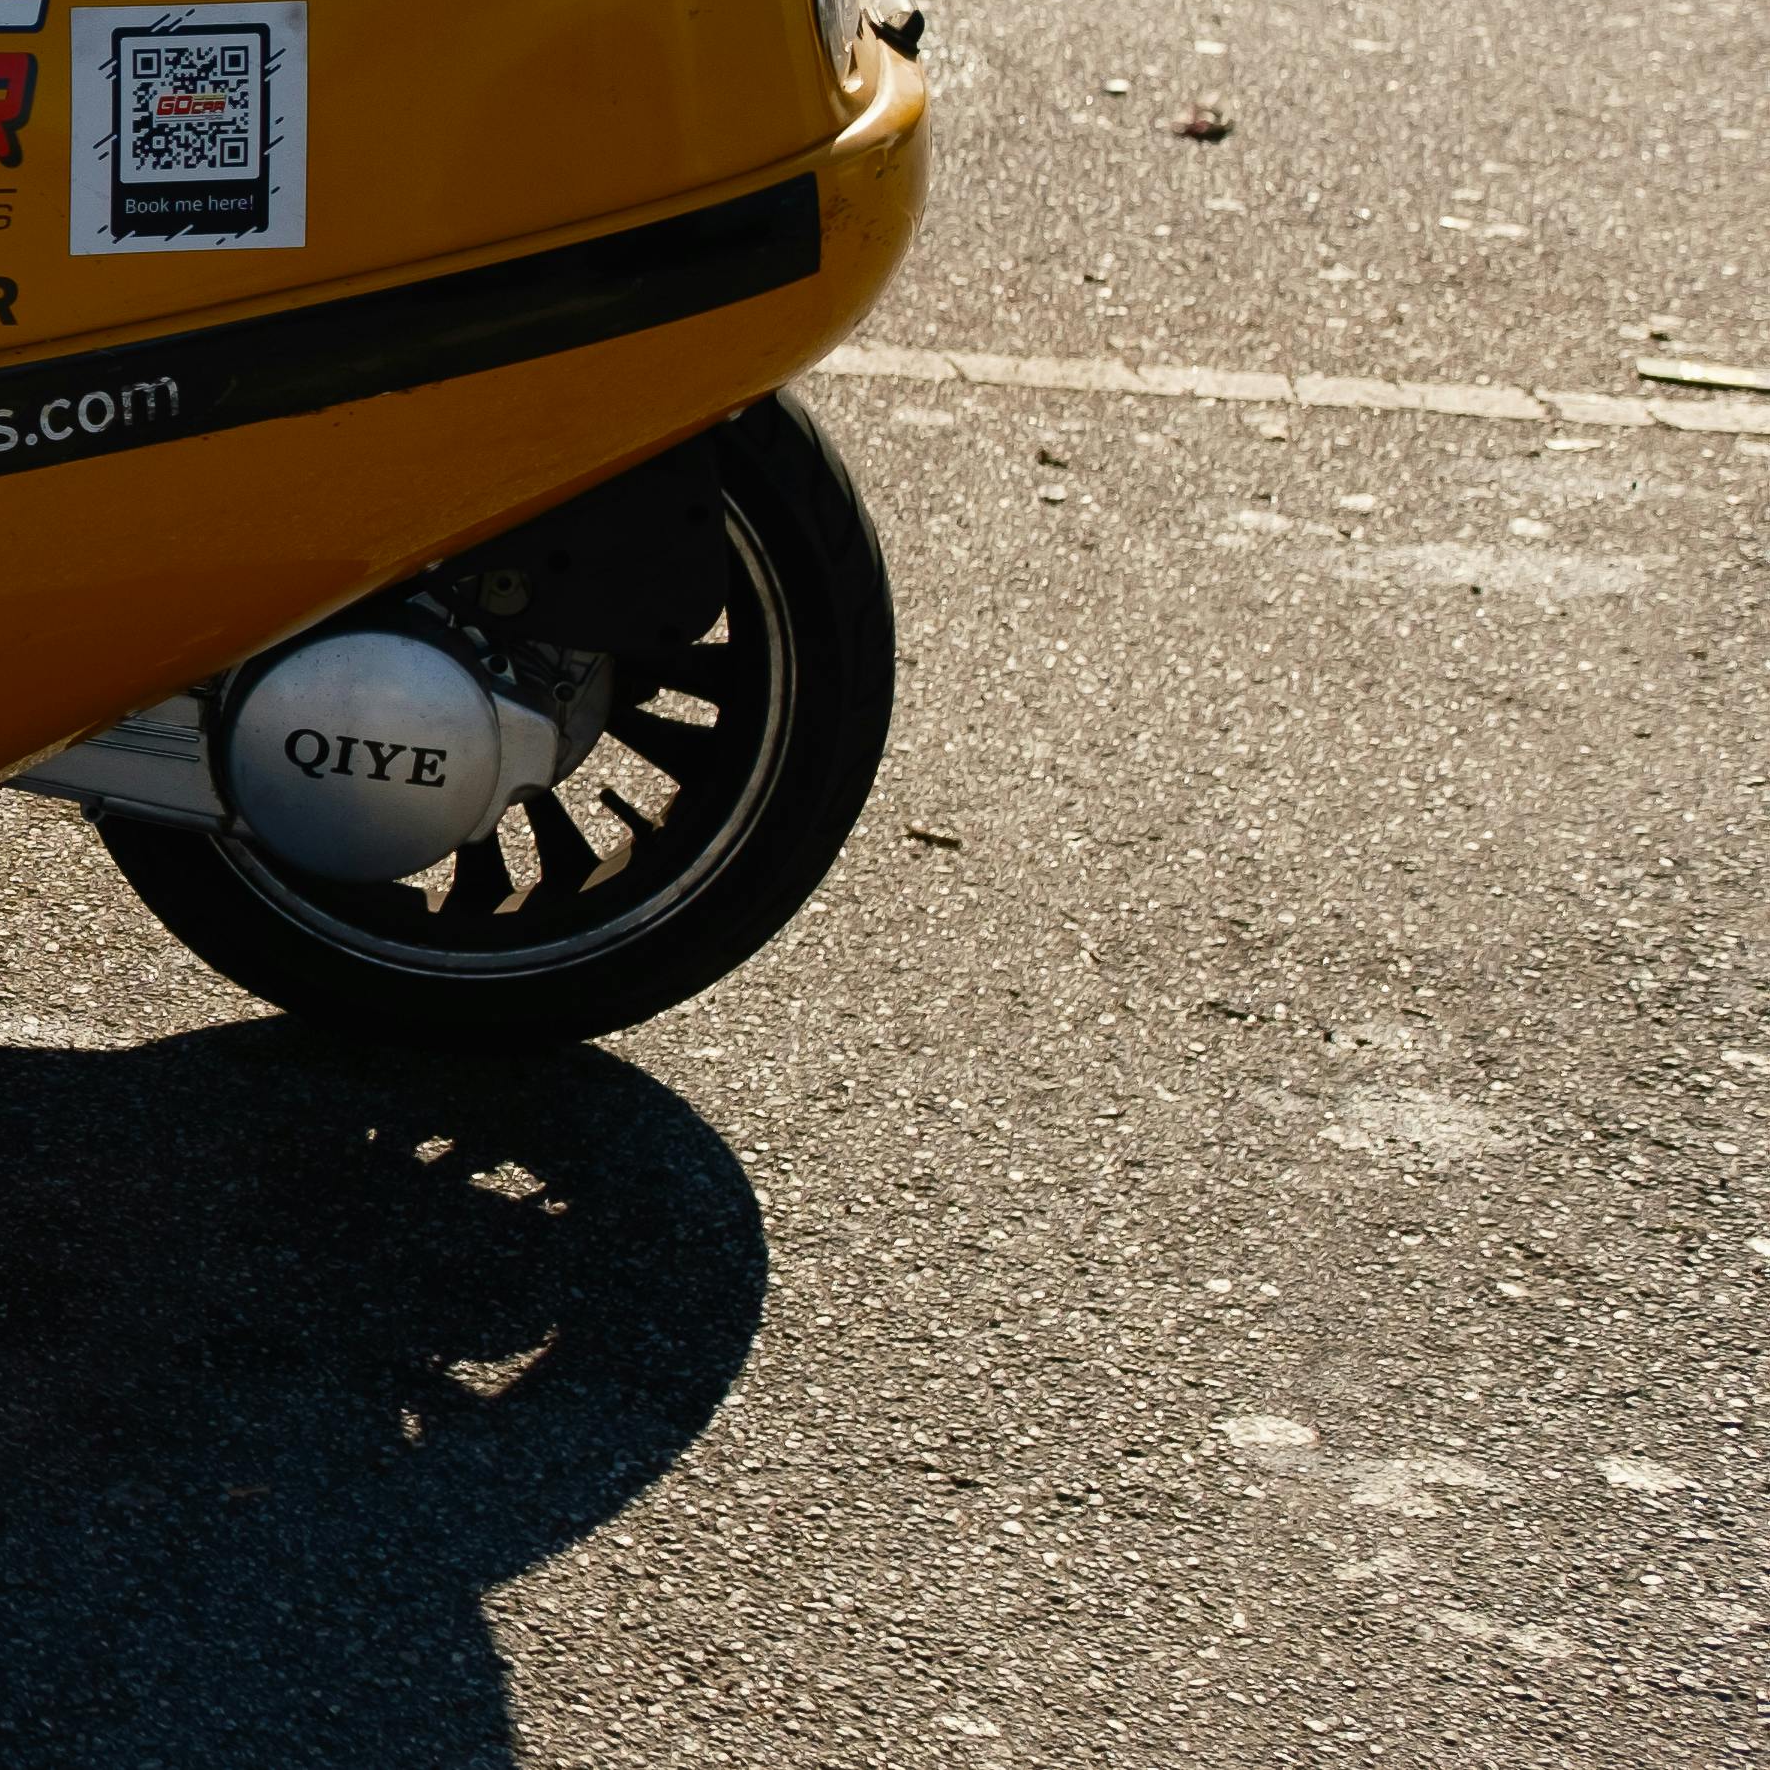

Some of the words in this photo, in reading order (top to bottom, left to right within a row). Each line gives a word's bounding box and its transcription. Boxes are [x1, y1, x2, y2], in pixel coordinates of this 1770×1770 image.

[126, 197, 169, 214] Book
[176, 200, 203, 213] me
[209, 194, 254, 211] here!
[284, 728, 447, 788] QIYE
